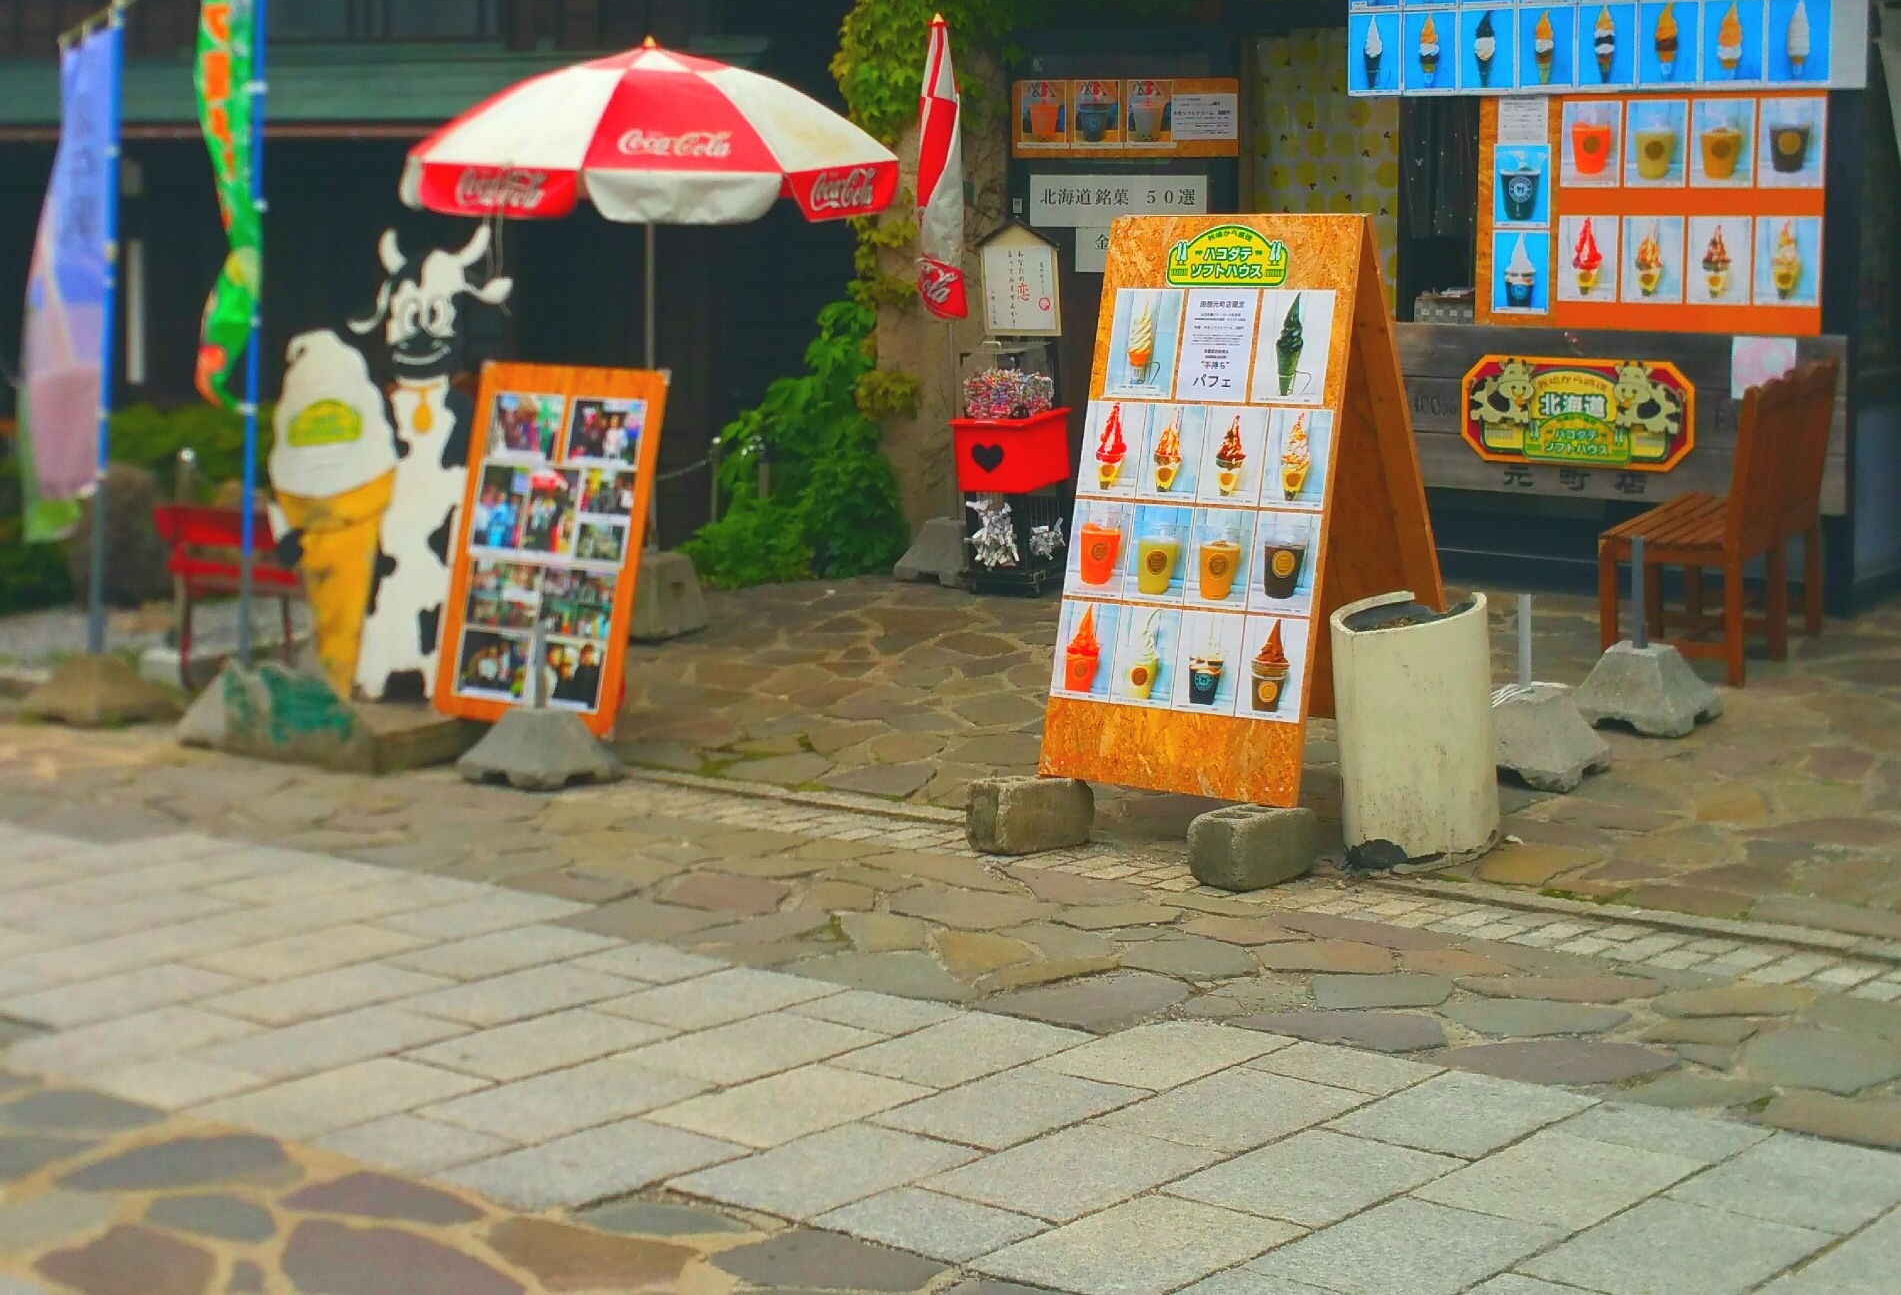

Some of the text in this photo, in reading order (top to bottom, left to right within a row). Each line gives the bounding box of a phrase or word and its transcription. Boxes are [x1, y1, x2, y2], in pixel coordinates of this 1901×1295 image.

[1040, 188, 1129, 205] 北海道銘菓
[1203, 246, 1253, 261] ハコダテ
[1190, 264, 1263, 279] ソフトハウス
[1192, 373, 1231, 388] パフェ
[1539, 392, 1607, 419] 北海道
[1555, 428, 1598, 441] ハコダテ
[1544, 441, 1609, 456] ソフトハウス
[1502, 464, 1648, 494] 元町店
